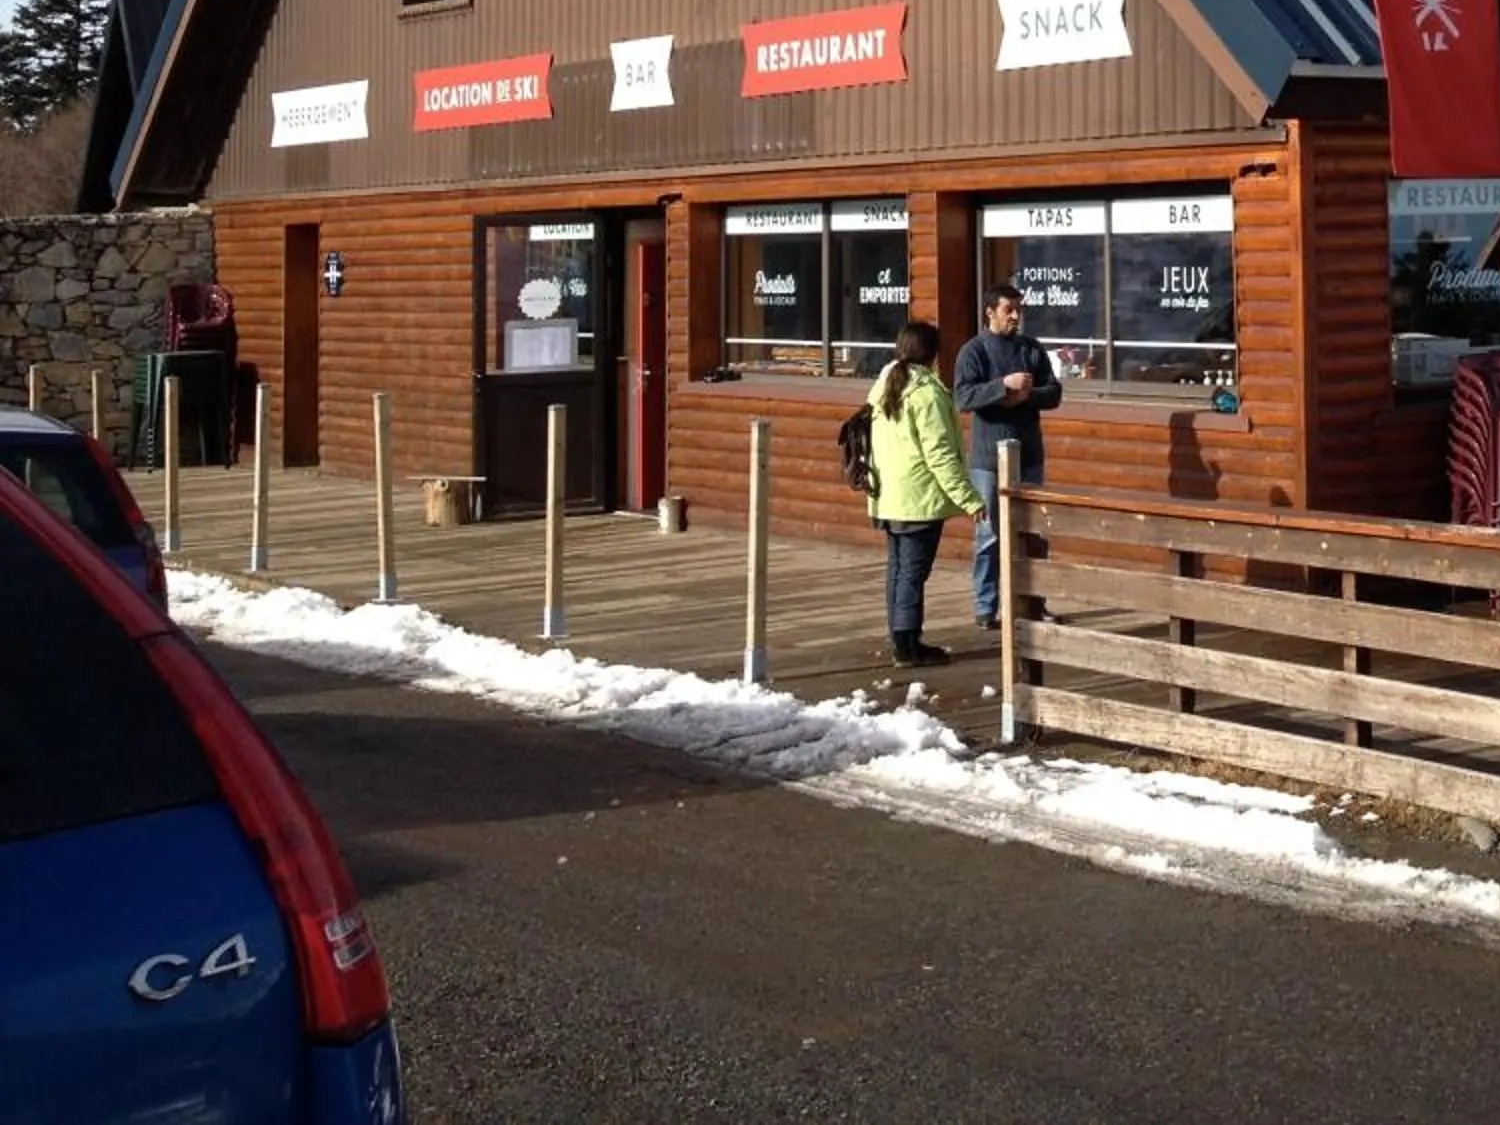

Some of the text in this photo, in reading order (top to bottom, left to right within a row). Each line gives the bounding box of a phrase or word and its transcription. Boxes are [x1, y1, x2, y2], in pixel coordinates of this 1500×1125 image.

[1019, 2, 1103, 39] SNACK
[756, 29, 886, 73] RESTAURANT
[625, 61, 656, 87] BAR
[424, 81, 492, 112] LOCATION
[514, 75, 538, 102] SKI
[745, 209, 819, 227] RESTAURANT
[862, 203, 908, 223] SNACK
[1027, 208, 1074, 227] TAPAS
[1168, 204, 1202, 224] BAR
[1023, 267, 1073, 282] PORTIONS
[1160, 266, 1209, 293] JEUX
[129, 933, 256, 1001] C4
